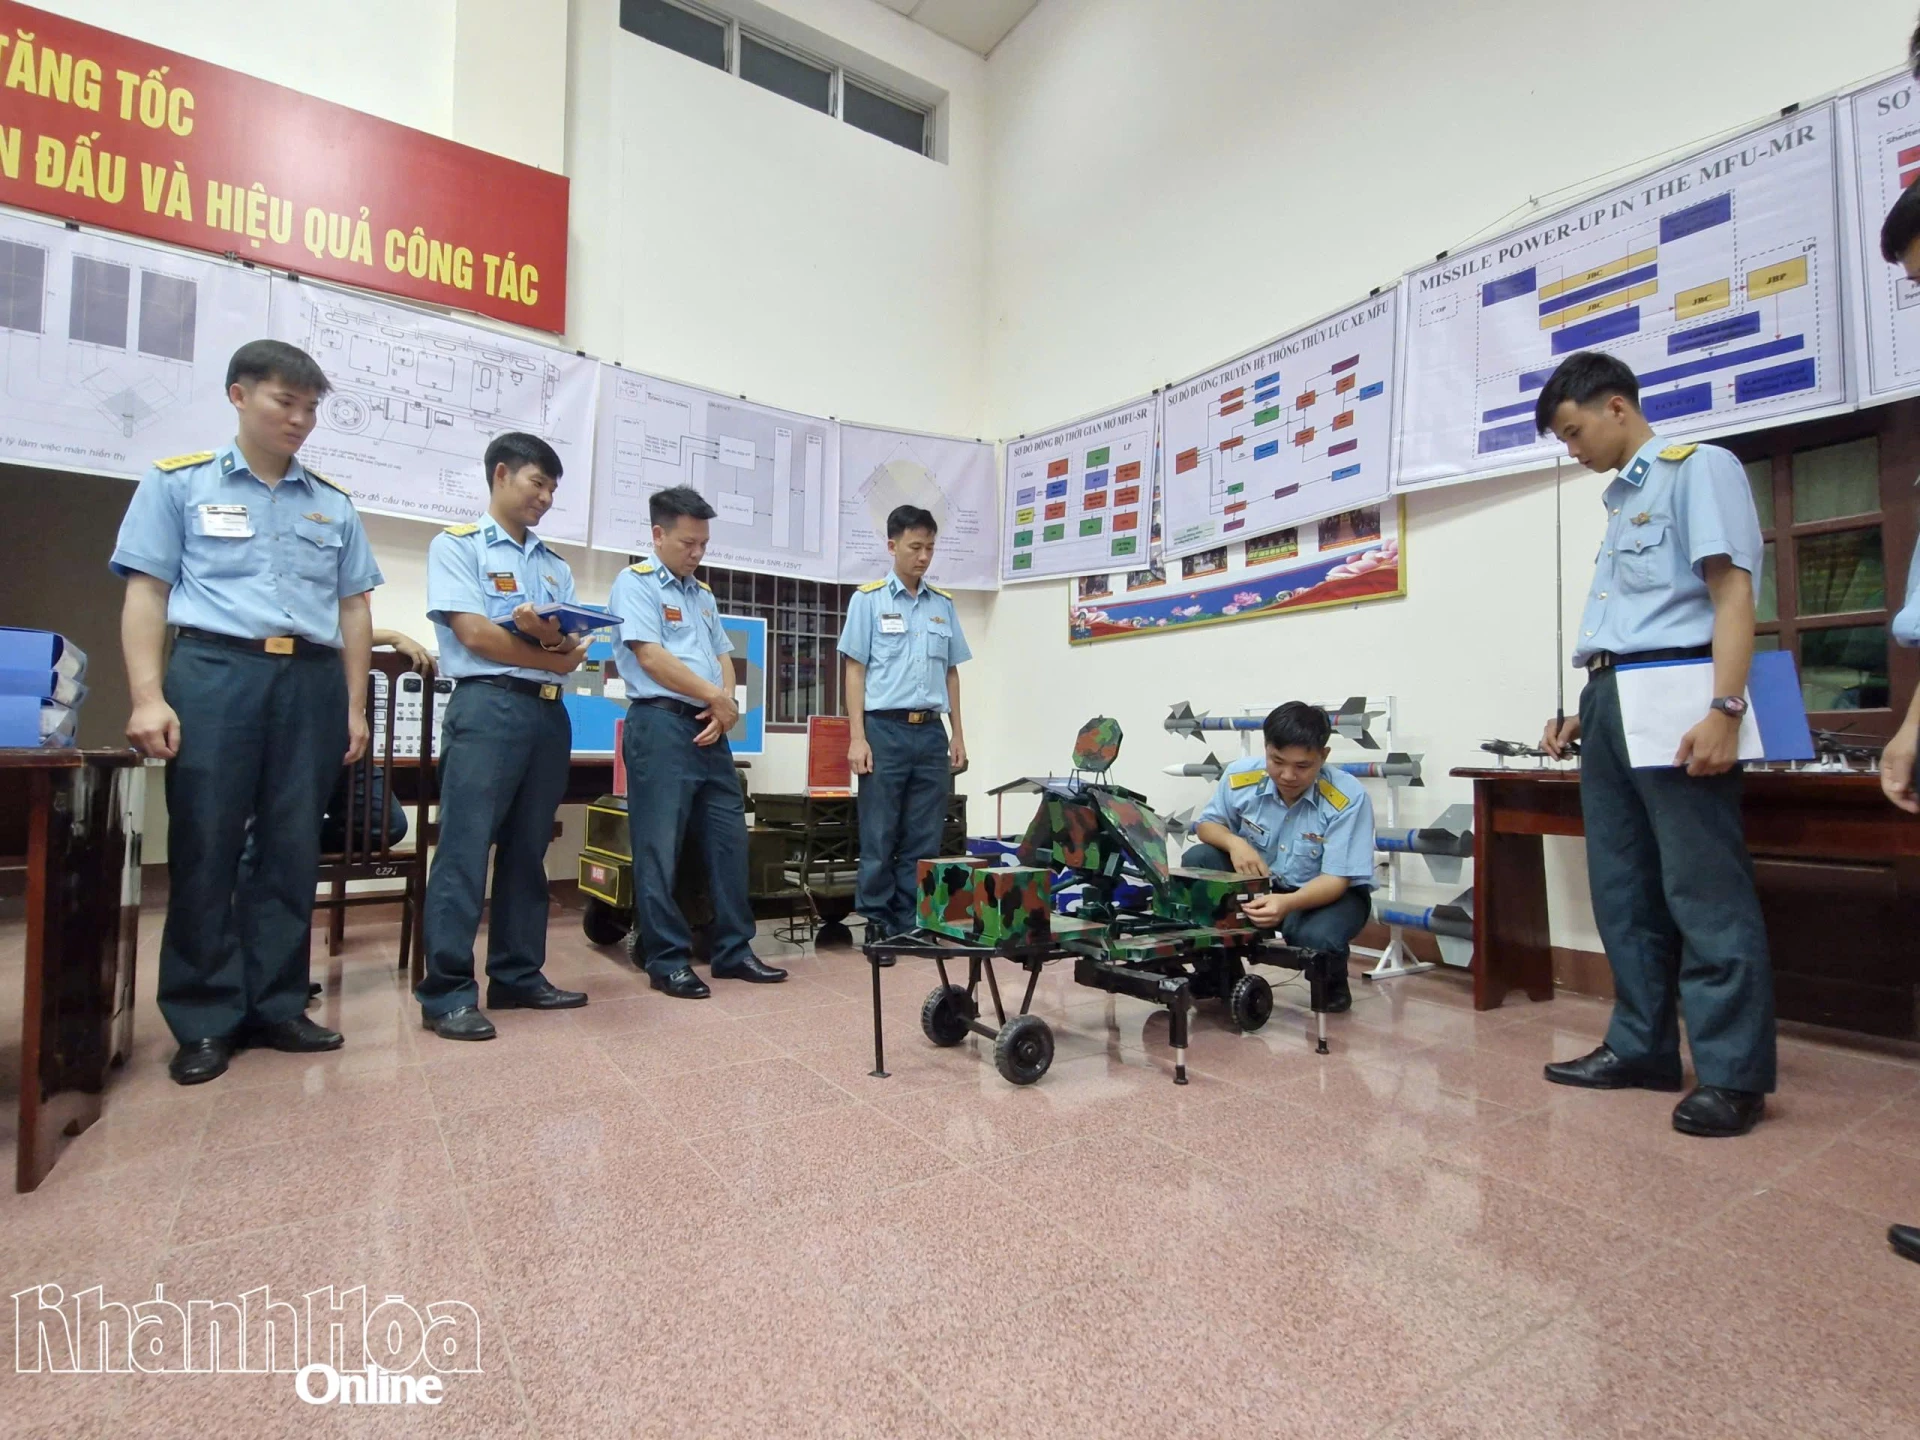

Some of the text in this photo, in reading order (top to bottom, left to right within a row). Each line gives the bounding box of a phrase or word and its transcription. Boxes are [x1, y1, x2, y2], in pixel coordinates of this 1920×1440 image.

[116, 66, 194, 136] TỐC
[35, 131, 126, 204] ĐẤU
[141, 161, 193, 222] VÀ
[206, 182, 292, 248] HIỆU
[304, 206, 373, 266] QUẢ
[384, 226, 473, 290] CÔNG
[483, 252, 539, 306] TÁC
[1419, 253, 1493, 293] MISSILE
[1498, 208, 1606, 265] POWER-UP
[1610, 196, 1636, 220] IN
[1641, 173, 1692, 207] THE
[1699, 125, 1816, 184] MFU-MR
[1351, 311, 1365, 327] XE
